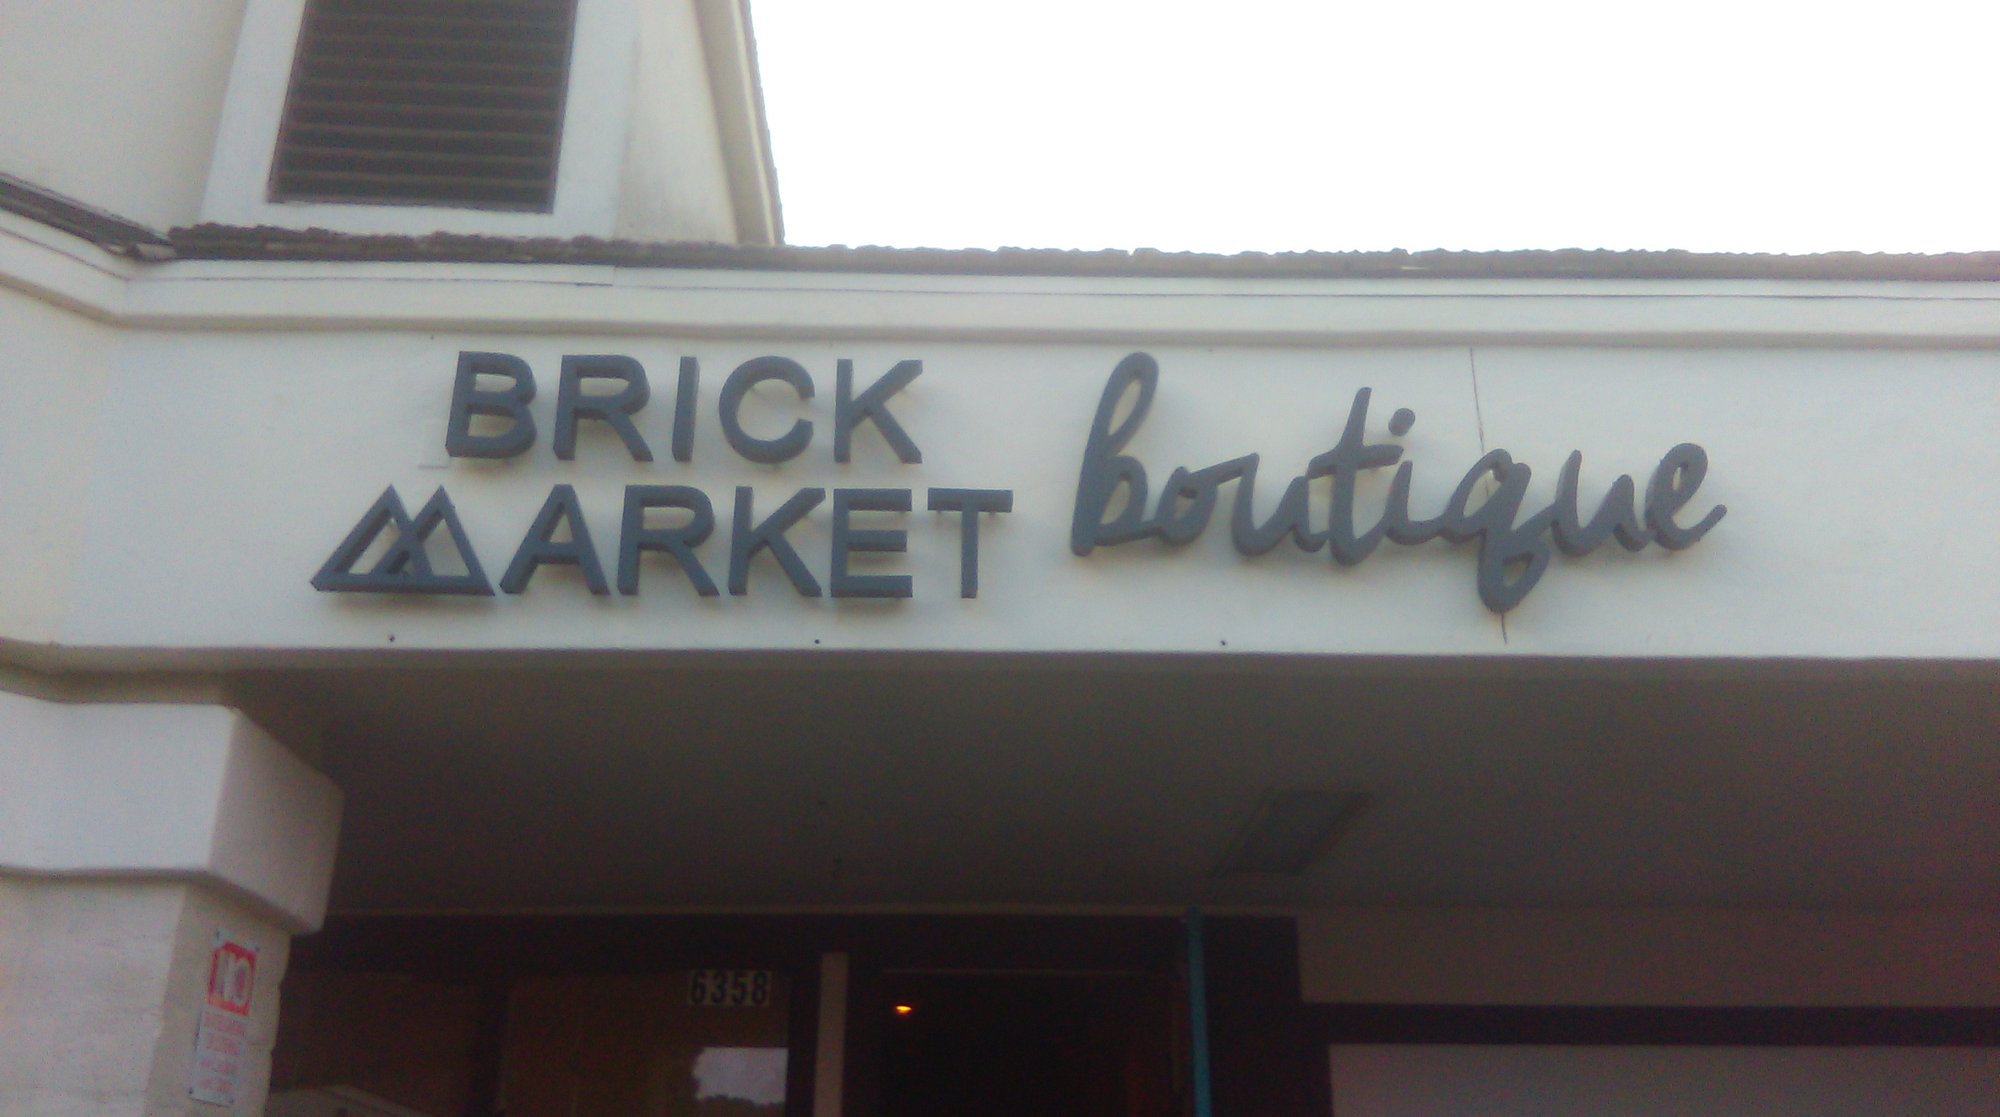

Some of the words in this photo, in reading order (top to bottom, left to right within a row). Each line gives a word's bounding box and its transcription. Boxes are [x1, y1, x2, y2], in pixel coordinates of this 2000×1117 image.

[445, 351, 924, 465] BRICK
[1070, 352, 1728, 613] boutique
[310, 484, 1014, 600] MARKET
[211, 949, 252, 1005] NO
[690, 970, 769, 1004] 6358
